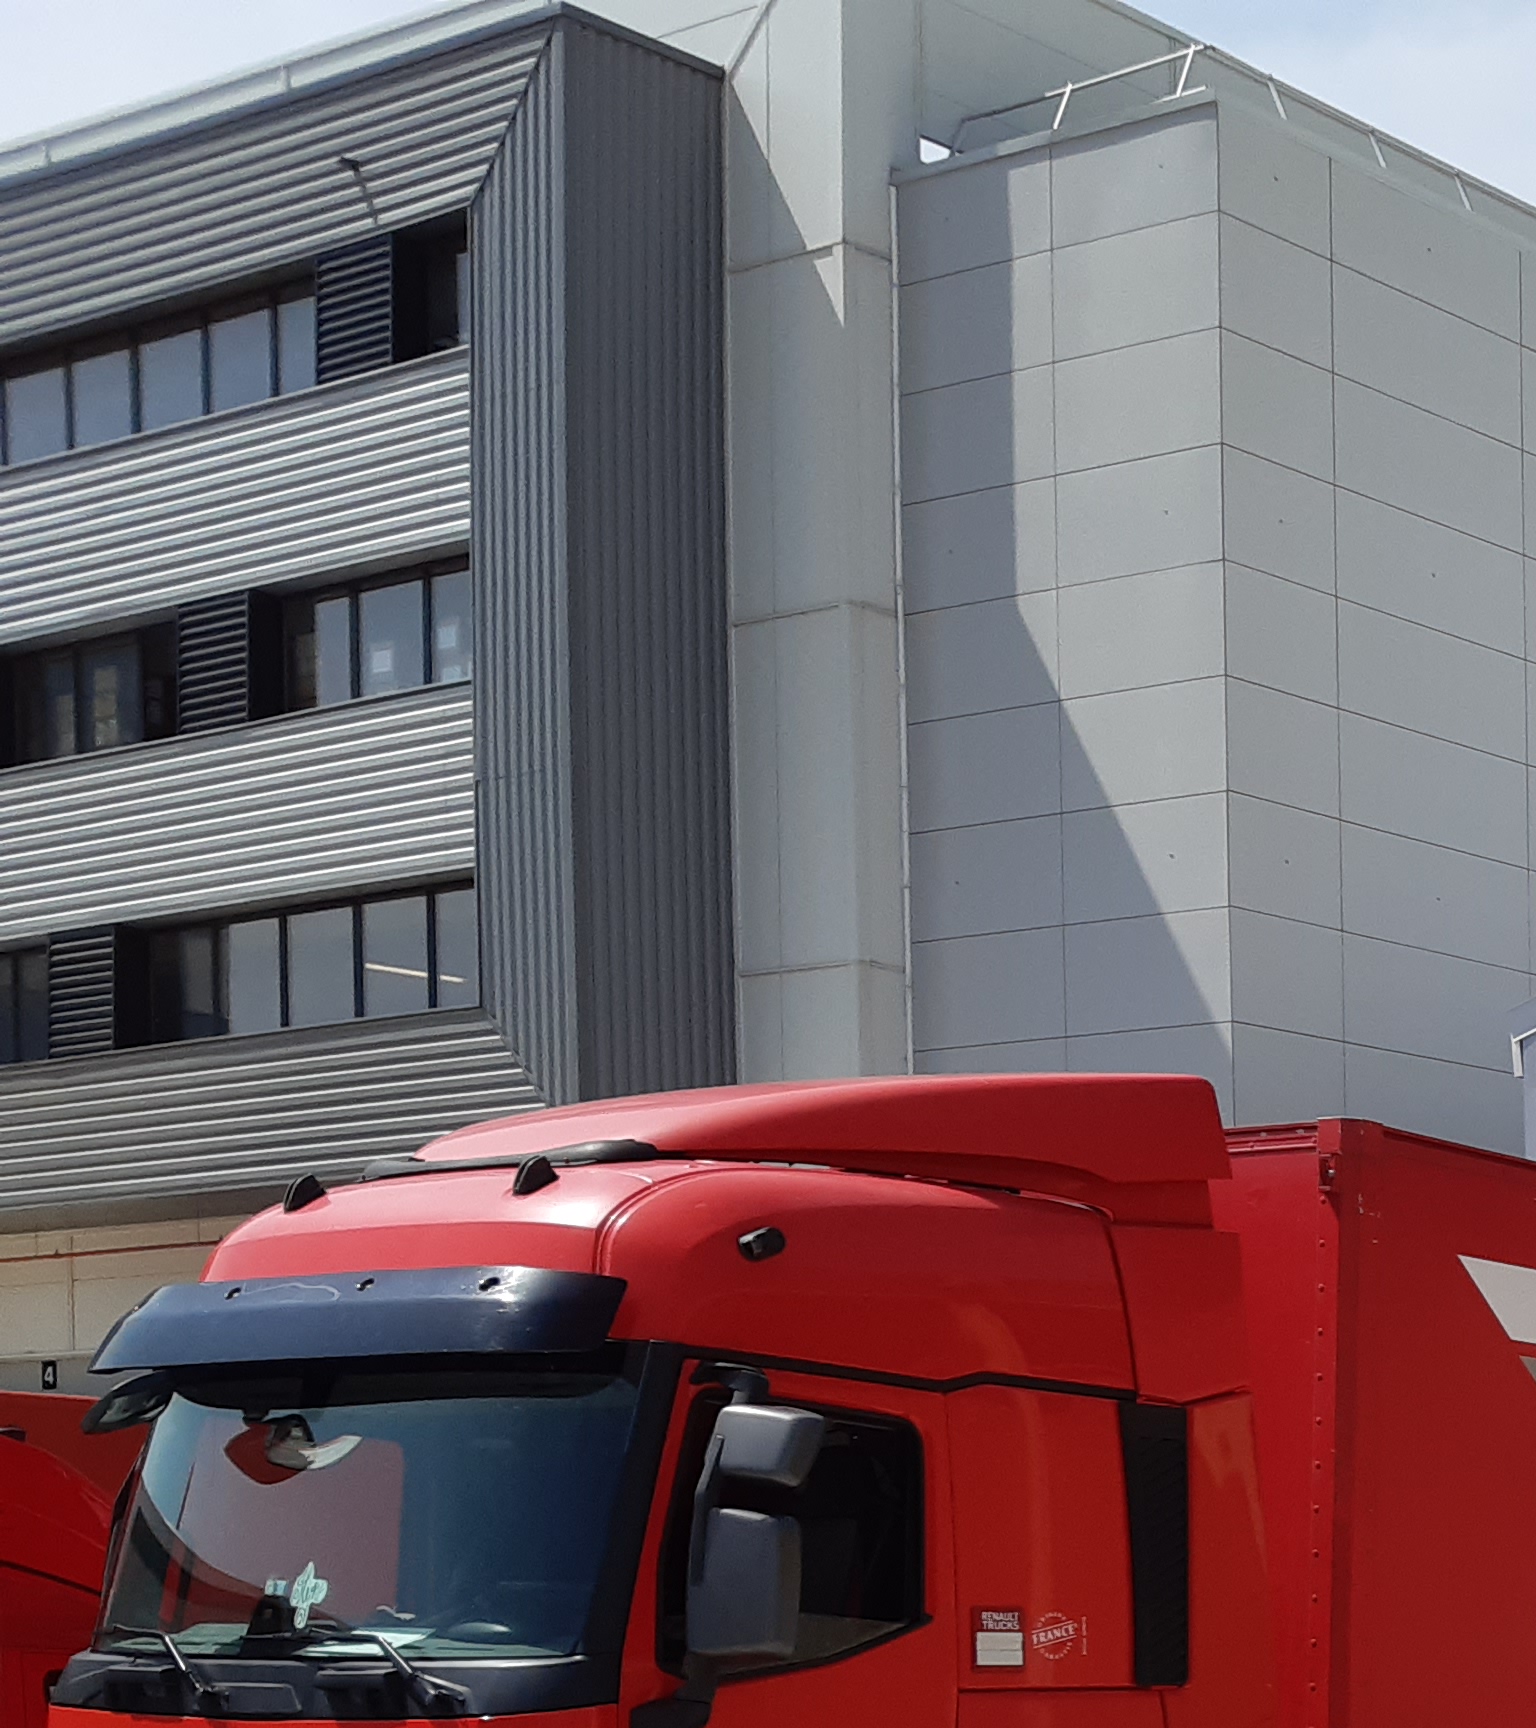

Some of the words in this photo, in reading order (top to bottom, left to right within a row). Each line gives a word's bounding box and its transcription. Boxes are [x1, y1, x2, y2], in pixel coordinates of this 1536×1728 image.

[44, 1366, 54, 1385] 4
[981, 1611, 1019, 1620] RENAULT
[982, 1621, 1020, 1630] TRUCKS
[1032, 1624, 1076, 1645] FRANCE
